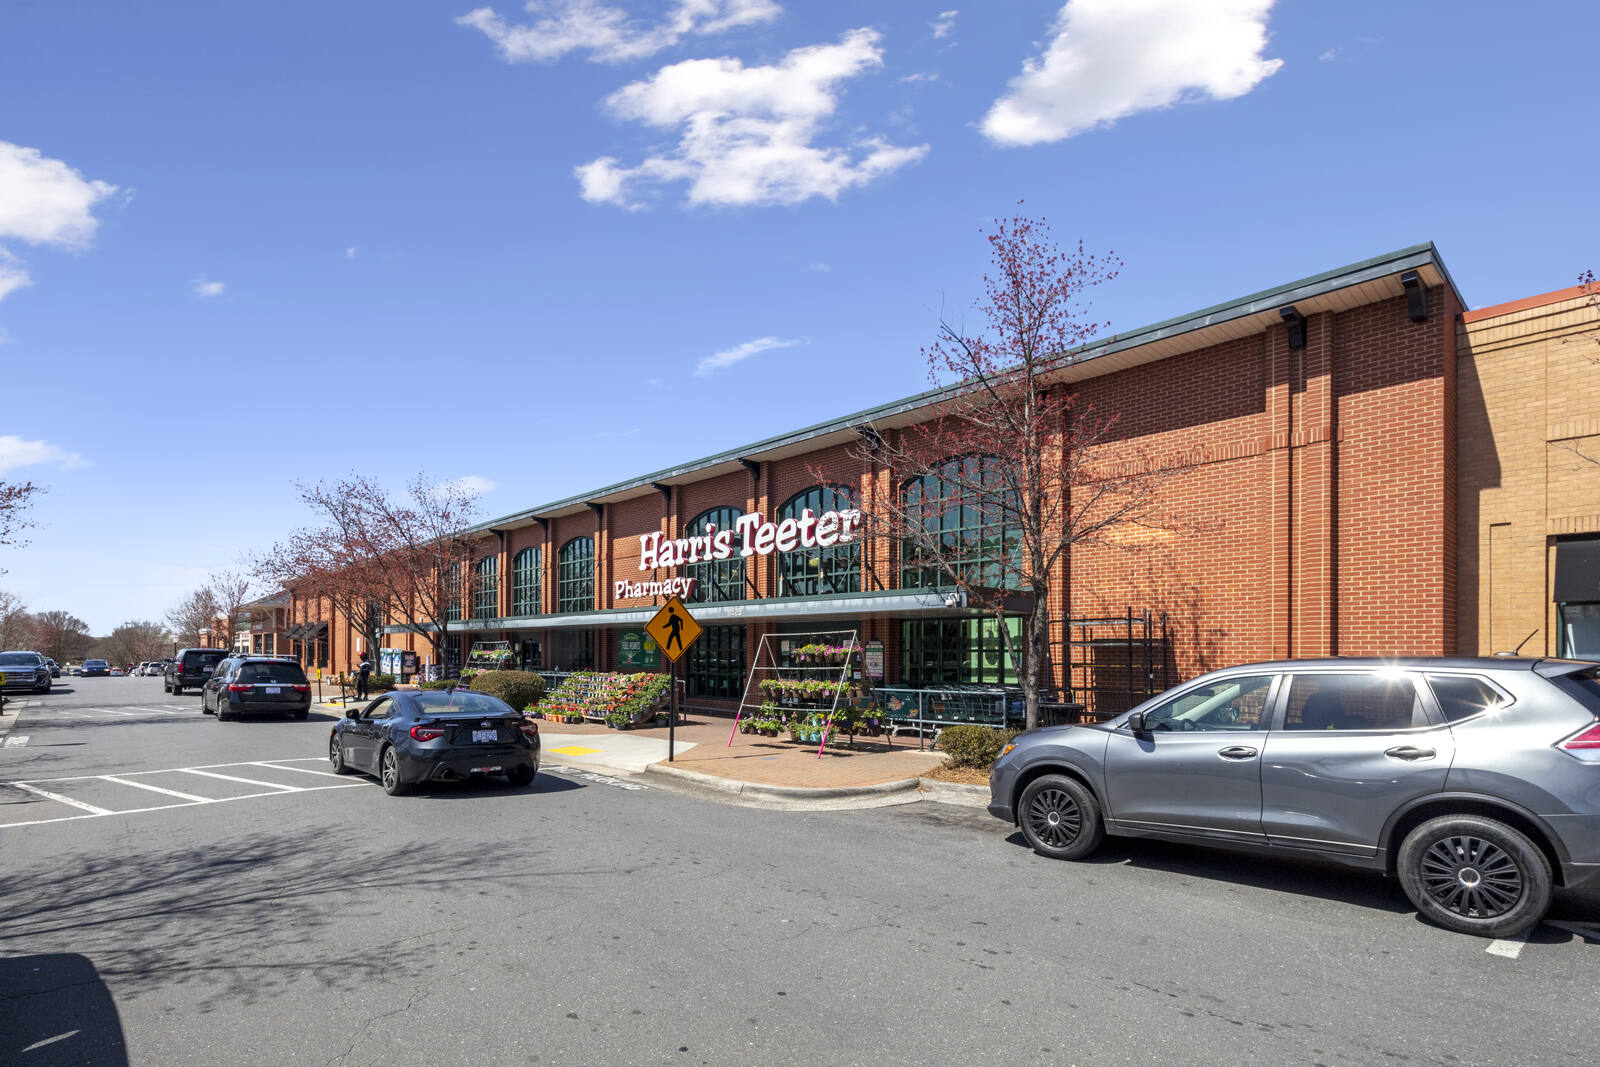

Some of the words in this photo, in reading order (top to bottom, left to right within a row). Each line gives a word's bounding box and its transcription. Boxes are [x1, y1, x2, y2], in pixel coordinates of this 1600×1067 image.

[639, 523, 734, 571] Harris
[736, 508, 862, 558] Teeter
[615, 577, 694, 601] Pharmacy
